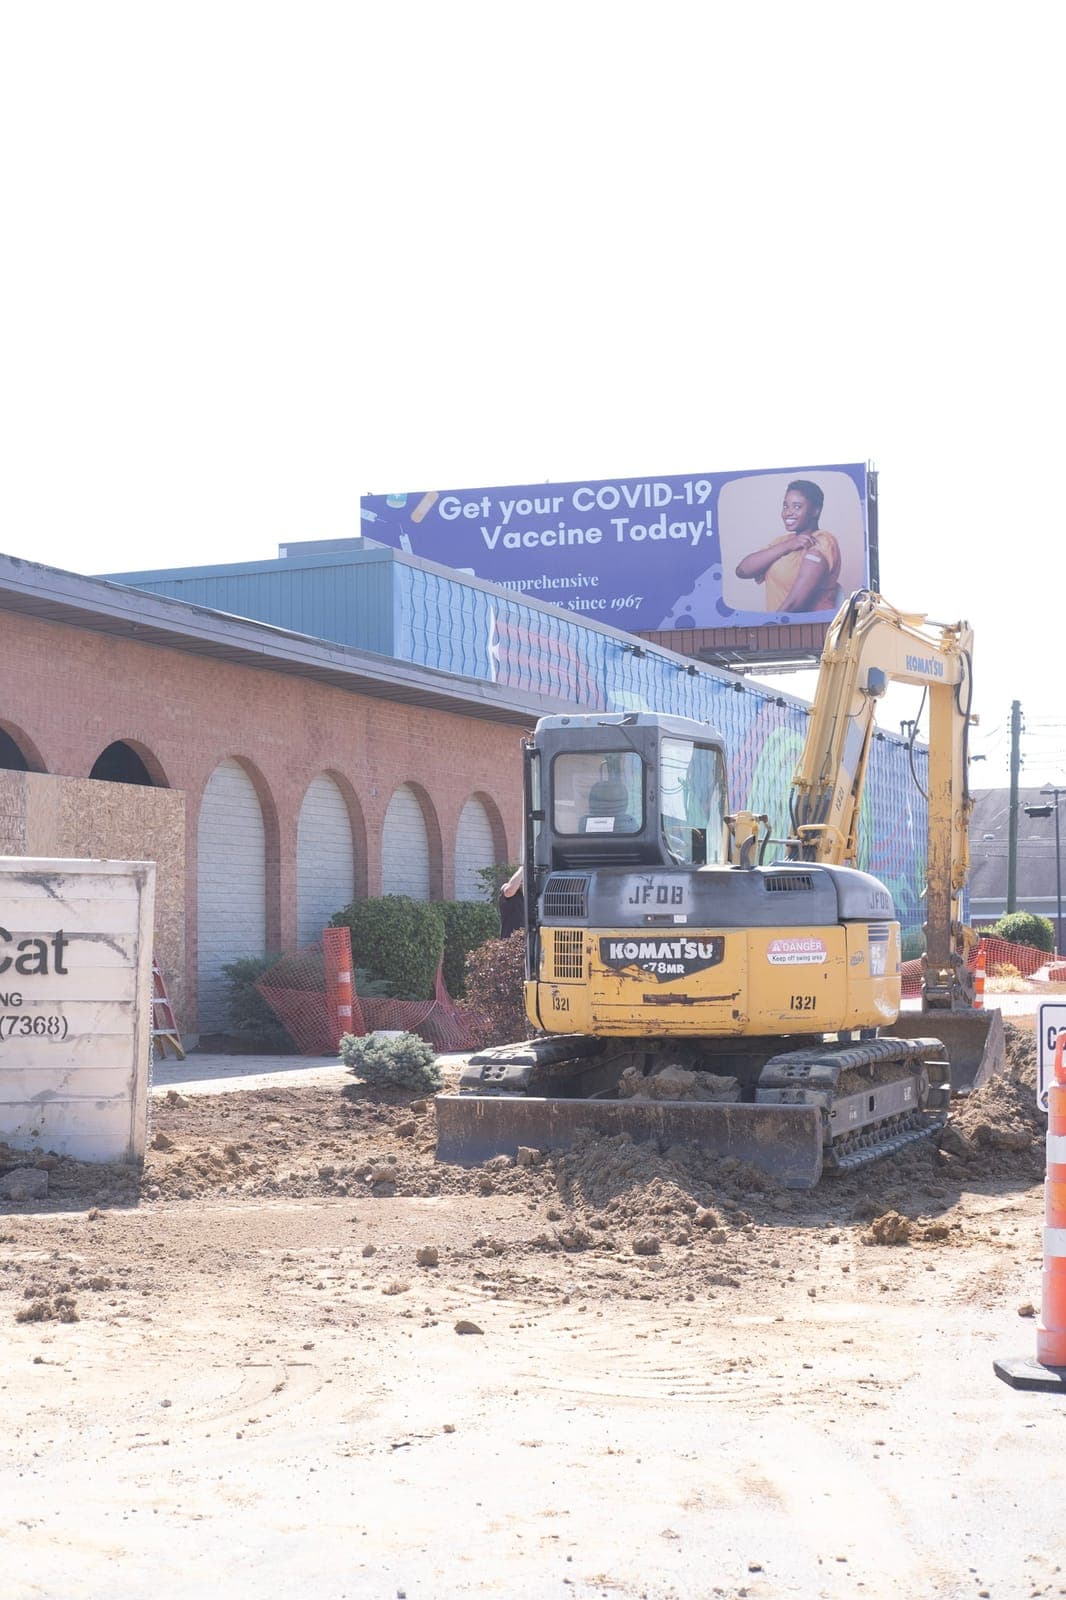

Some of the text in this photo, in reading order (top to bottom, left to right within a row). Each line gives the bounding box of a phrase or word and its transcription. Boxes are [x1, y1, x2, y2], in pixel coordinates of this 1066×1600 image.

[438, 480, 712, 524] Get your COVID-19
[480, 510, 713, 550] Vaccine Today!
[487, 573, 599, 593] mprehensive
[568, 596, 606, 611] since
[610, 594, 643, 611] 1967
[905, 654, 944, 677] KOMATSU
[609, 938, 713, 960] KOMATSU
[782, 941, 822, 952] DANGER
[642, 962, 685, 974] 78MR
[552, 997, 570, 1011] 1321
[790, 995, 817, 1010] 1321
[0, 1015, 68, 1040] (7368)
